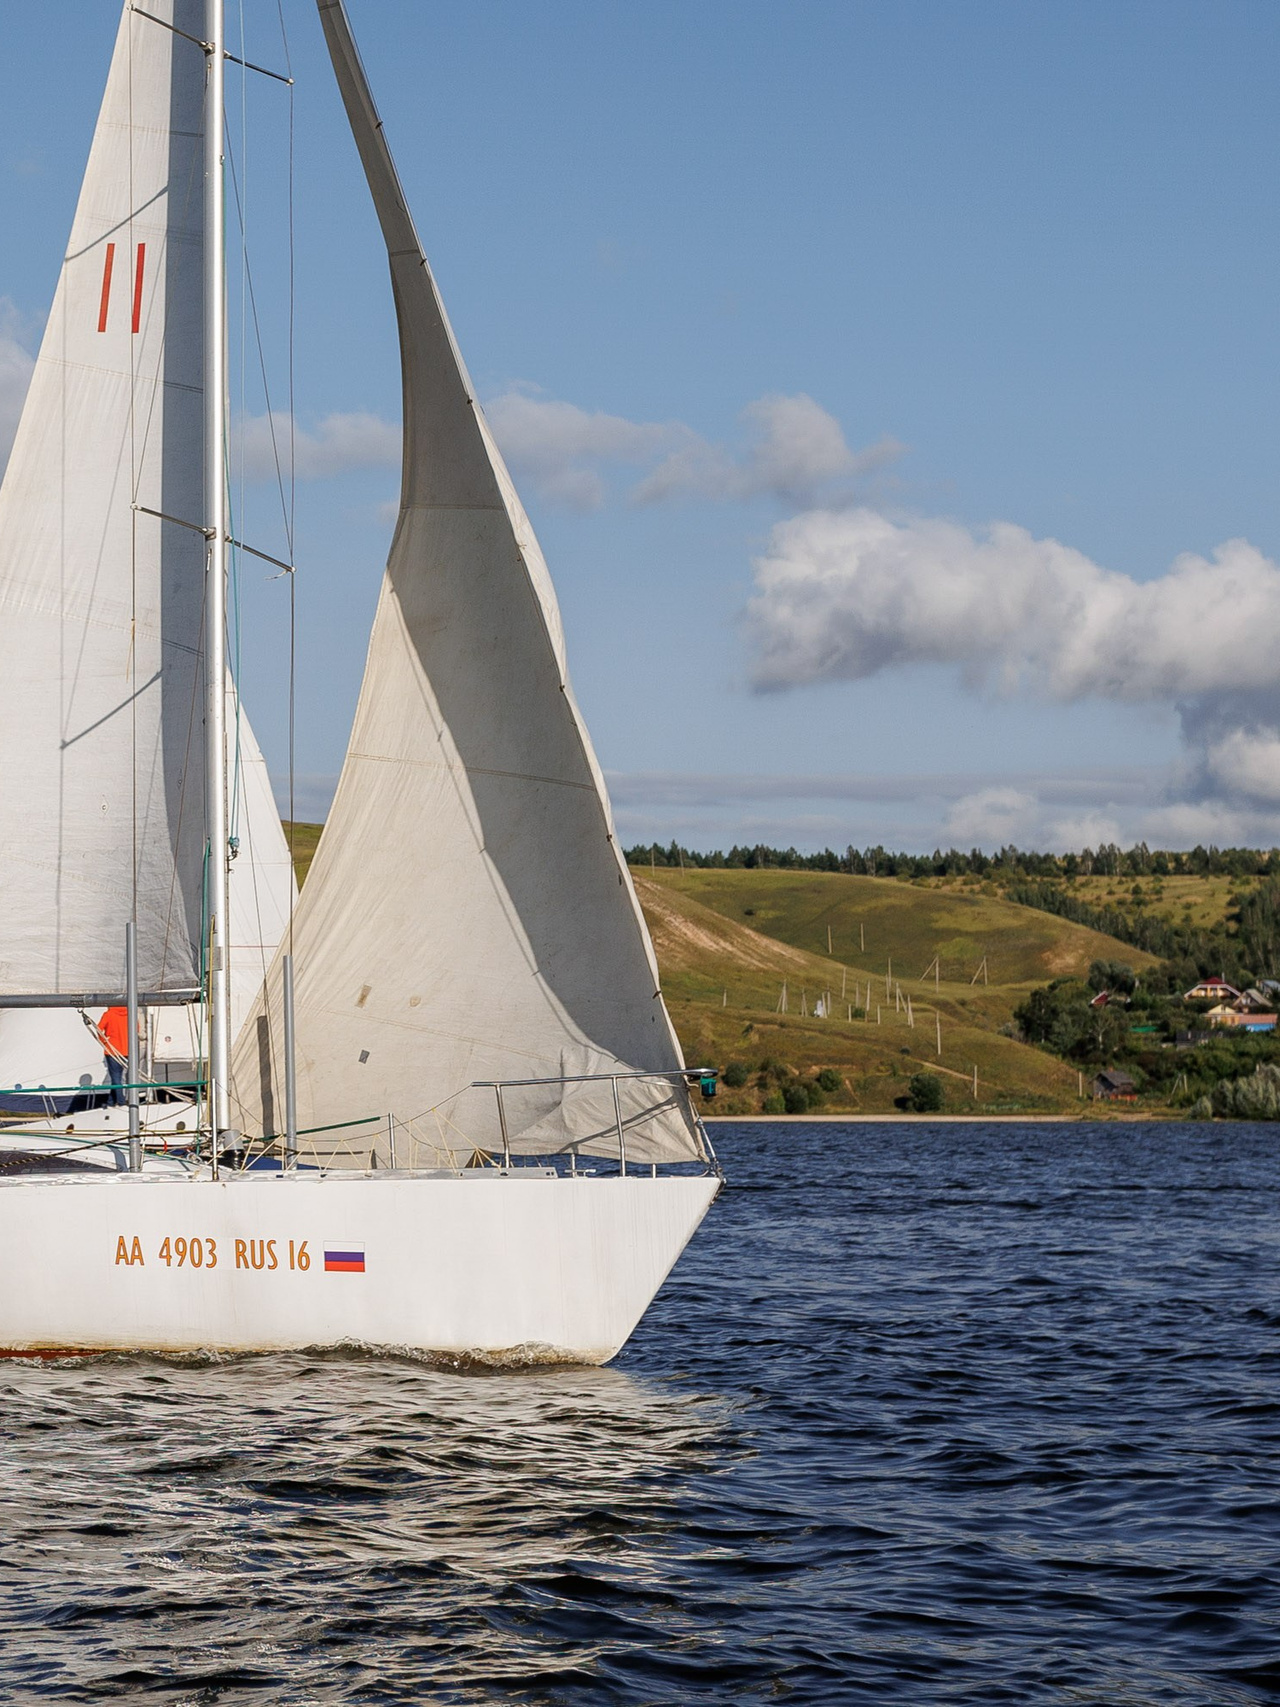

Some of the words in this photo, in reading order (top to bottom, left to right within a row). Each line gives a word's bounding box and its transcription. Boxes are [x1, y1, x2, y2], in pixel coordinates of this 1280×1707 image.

[115, 1235, 145, 1266] AA
[158, 1236, 218, 1269] 4903
[234, 1239, 279, 1270] RUS
[289, 1240, 311, 1271] 16
